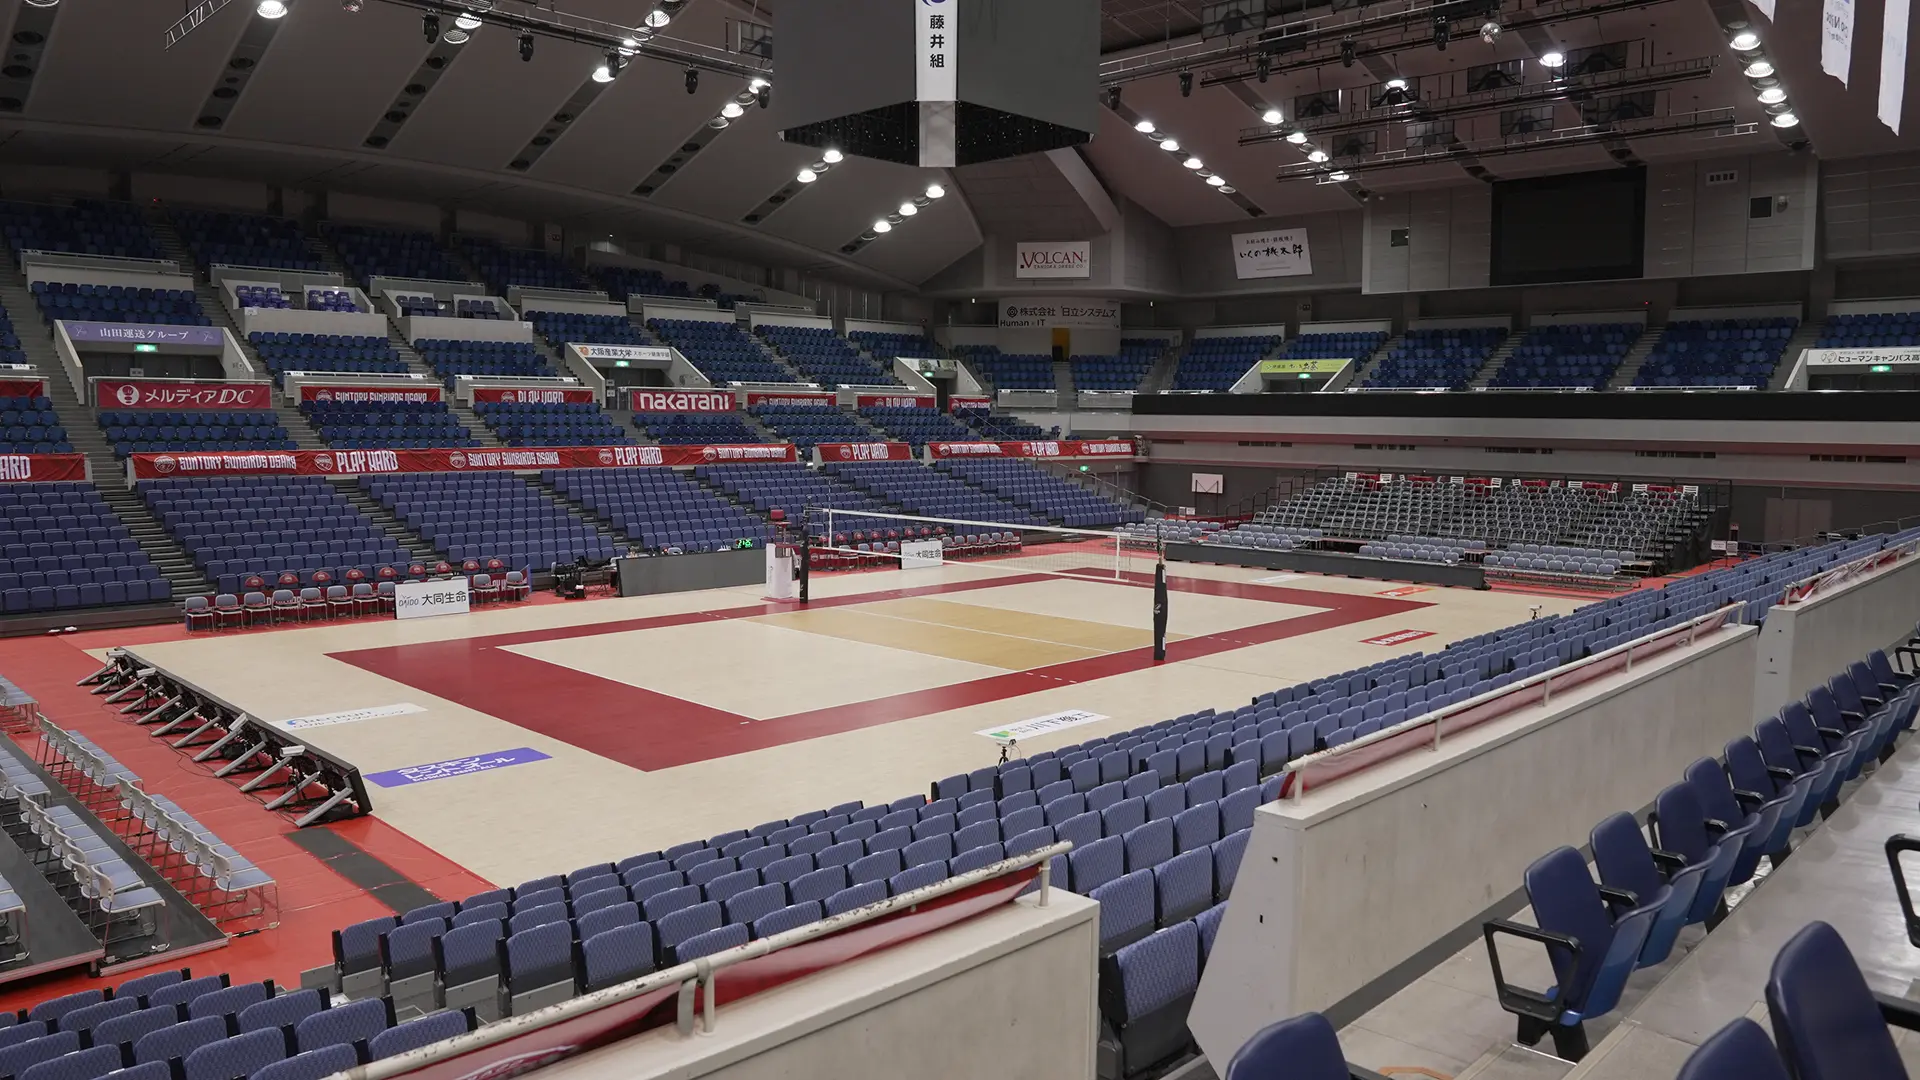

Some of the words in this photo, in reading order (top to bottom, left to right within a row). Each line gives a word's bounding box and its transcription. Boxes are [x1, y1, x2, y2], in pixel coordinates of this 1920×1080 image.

[930, 15, 944, 68] 藤井組
[1021, 251, 1083, 268] VOLCAN
[1019, 307, 1056, 317] 株式会社
[1062, 307, 1117, 318] 日立システムズ
[100, 327, 189, 341] 山田運送グループ
[591, 347, 632, 358] 大阪産業大学
[145, 388, 254, 404] メルディアDC
[468, 452, 501, 467] SUNTORY
[501, 451, 536, 466] SUNBIRDS
[536, 451, 560, 465] OSAKA
[614, 447, 638, 465] PLAY
[638, 447, 663, 465] HARD
[852, 444, 870, 460] PLAY
[178, 455, 221, 471] SUNTORY
[224, 455, 267, 470] SUNBIRDS
[269, 454, 297, 470] OSAKA
[335, 451, 365, 473] PLAY
[367, 450, 399, 472] HARD
[422, 590, 467, 606] 大同生命
